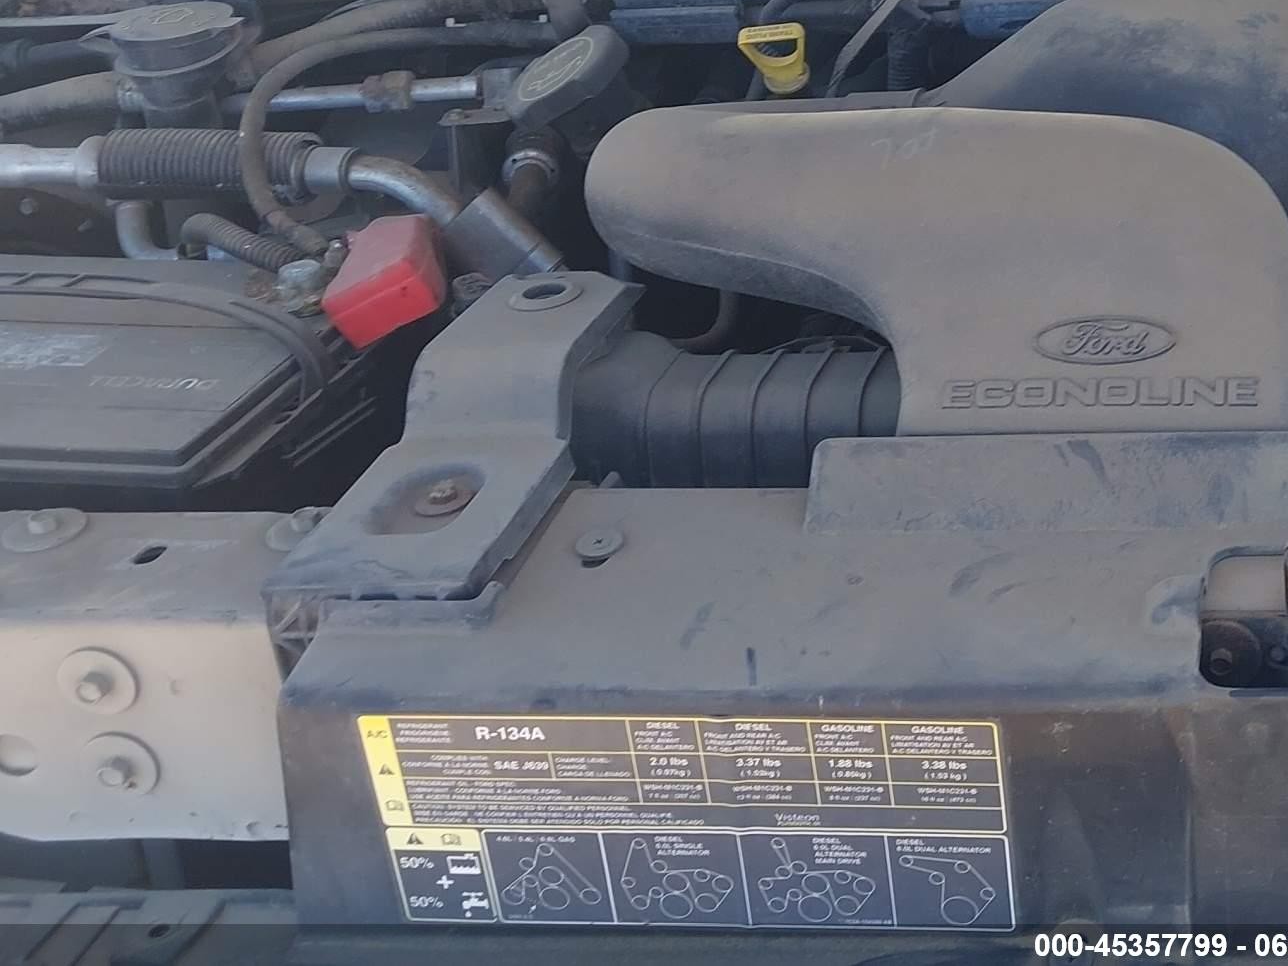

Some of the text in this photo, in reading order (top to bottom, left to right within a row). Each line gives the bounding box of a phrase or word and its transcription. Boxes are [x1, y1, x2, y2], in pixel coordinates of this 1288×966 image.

[1064, 321, 1149, 356] Ford
[941, 376, 1259, 409] ECONOLINE
[475, 726, 546, 740] R-134A
[821, 724, 875, 733] GASOLINE
[911, 726, 964, 734] GASOLINE
[493, 761, 520, 770] SAE
[649, 757, 689, 766] 2.0 lbs
[735, 757, 782, 767] 3.37 lbs
[854, 759, 873, 769] lbs
[948, 761, 968, 770] lbs
[774, 813, 820, 821] Visteon
[400, 856, 435, 869] 50%
[409, 896, 444, 908] 50%
